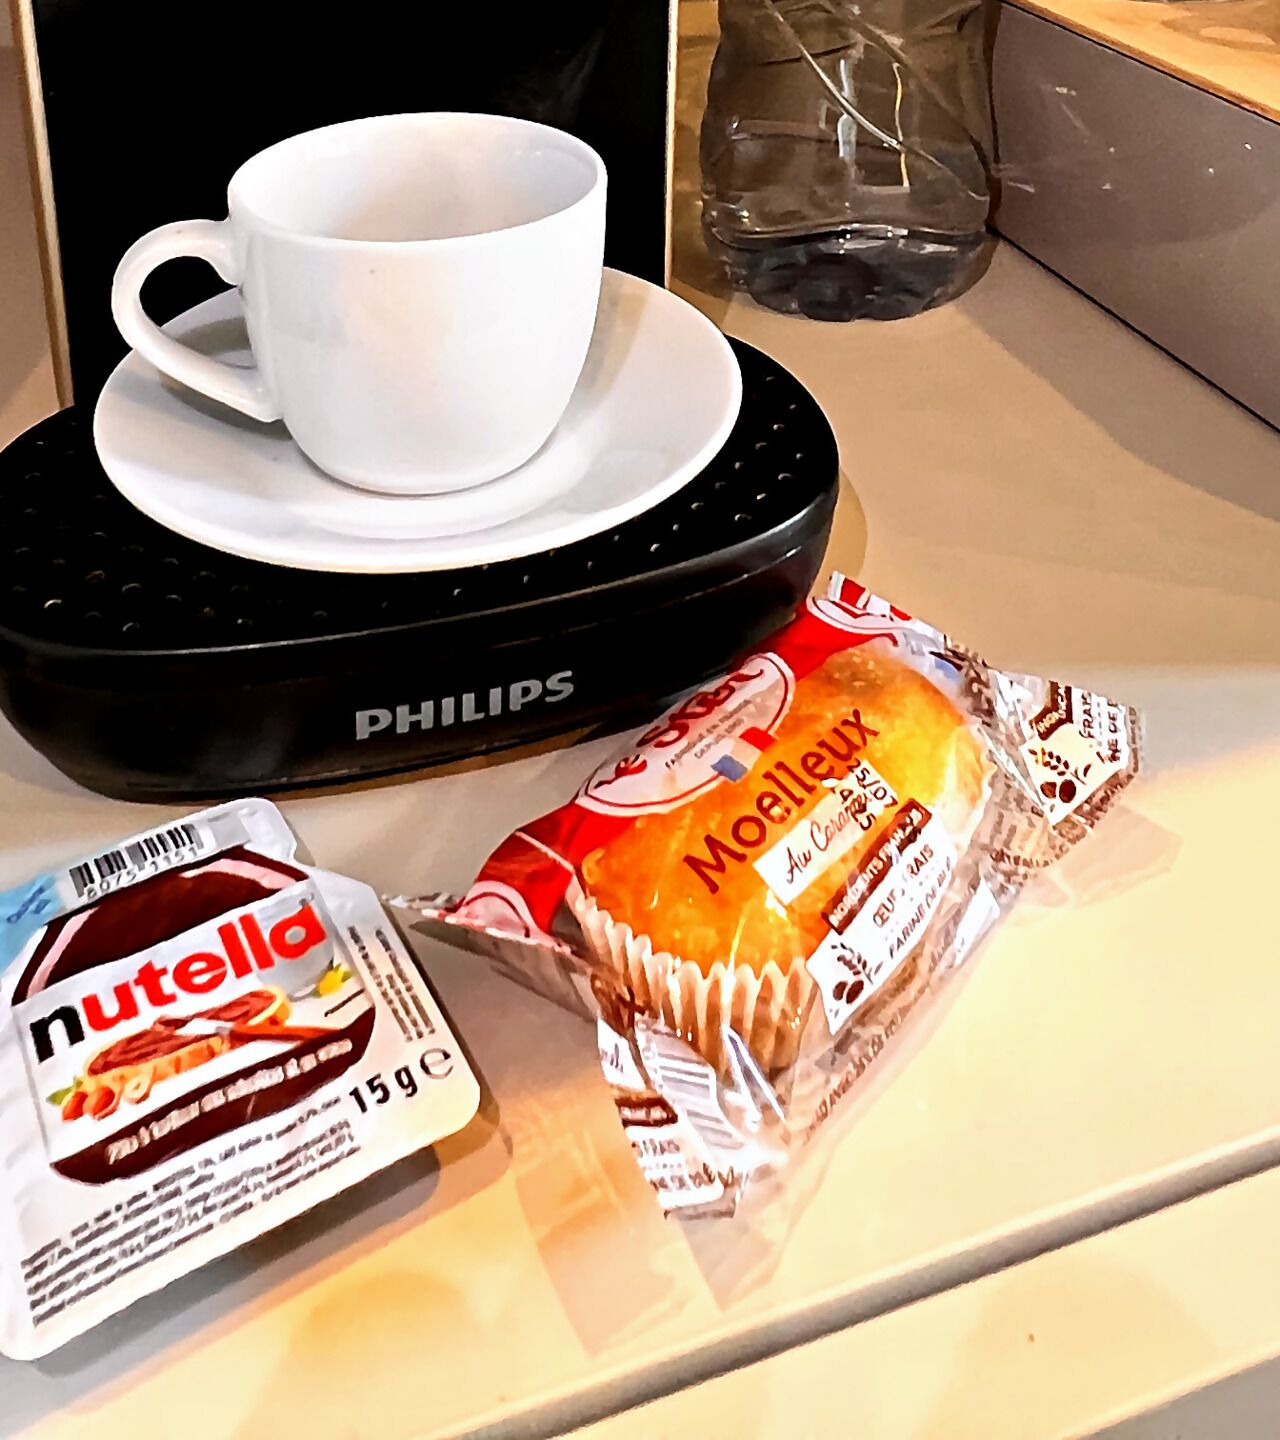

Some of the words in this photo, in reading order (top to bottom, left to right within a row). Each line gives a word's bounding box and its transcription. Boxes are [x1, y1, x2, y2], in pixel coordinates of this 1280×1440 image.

[355, 669, 575, 741] PHILIPS
[682, 708, 880, 895] Moelleux
[28, 902, 327, 1066] nutella
